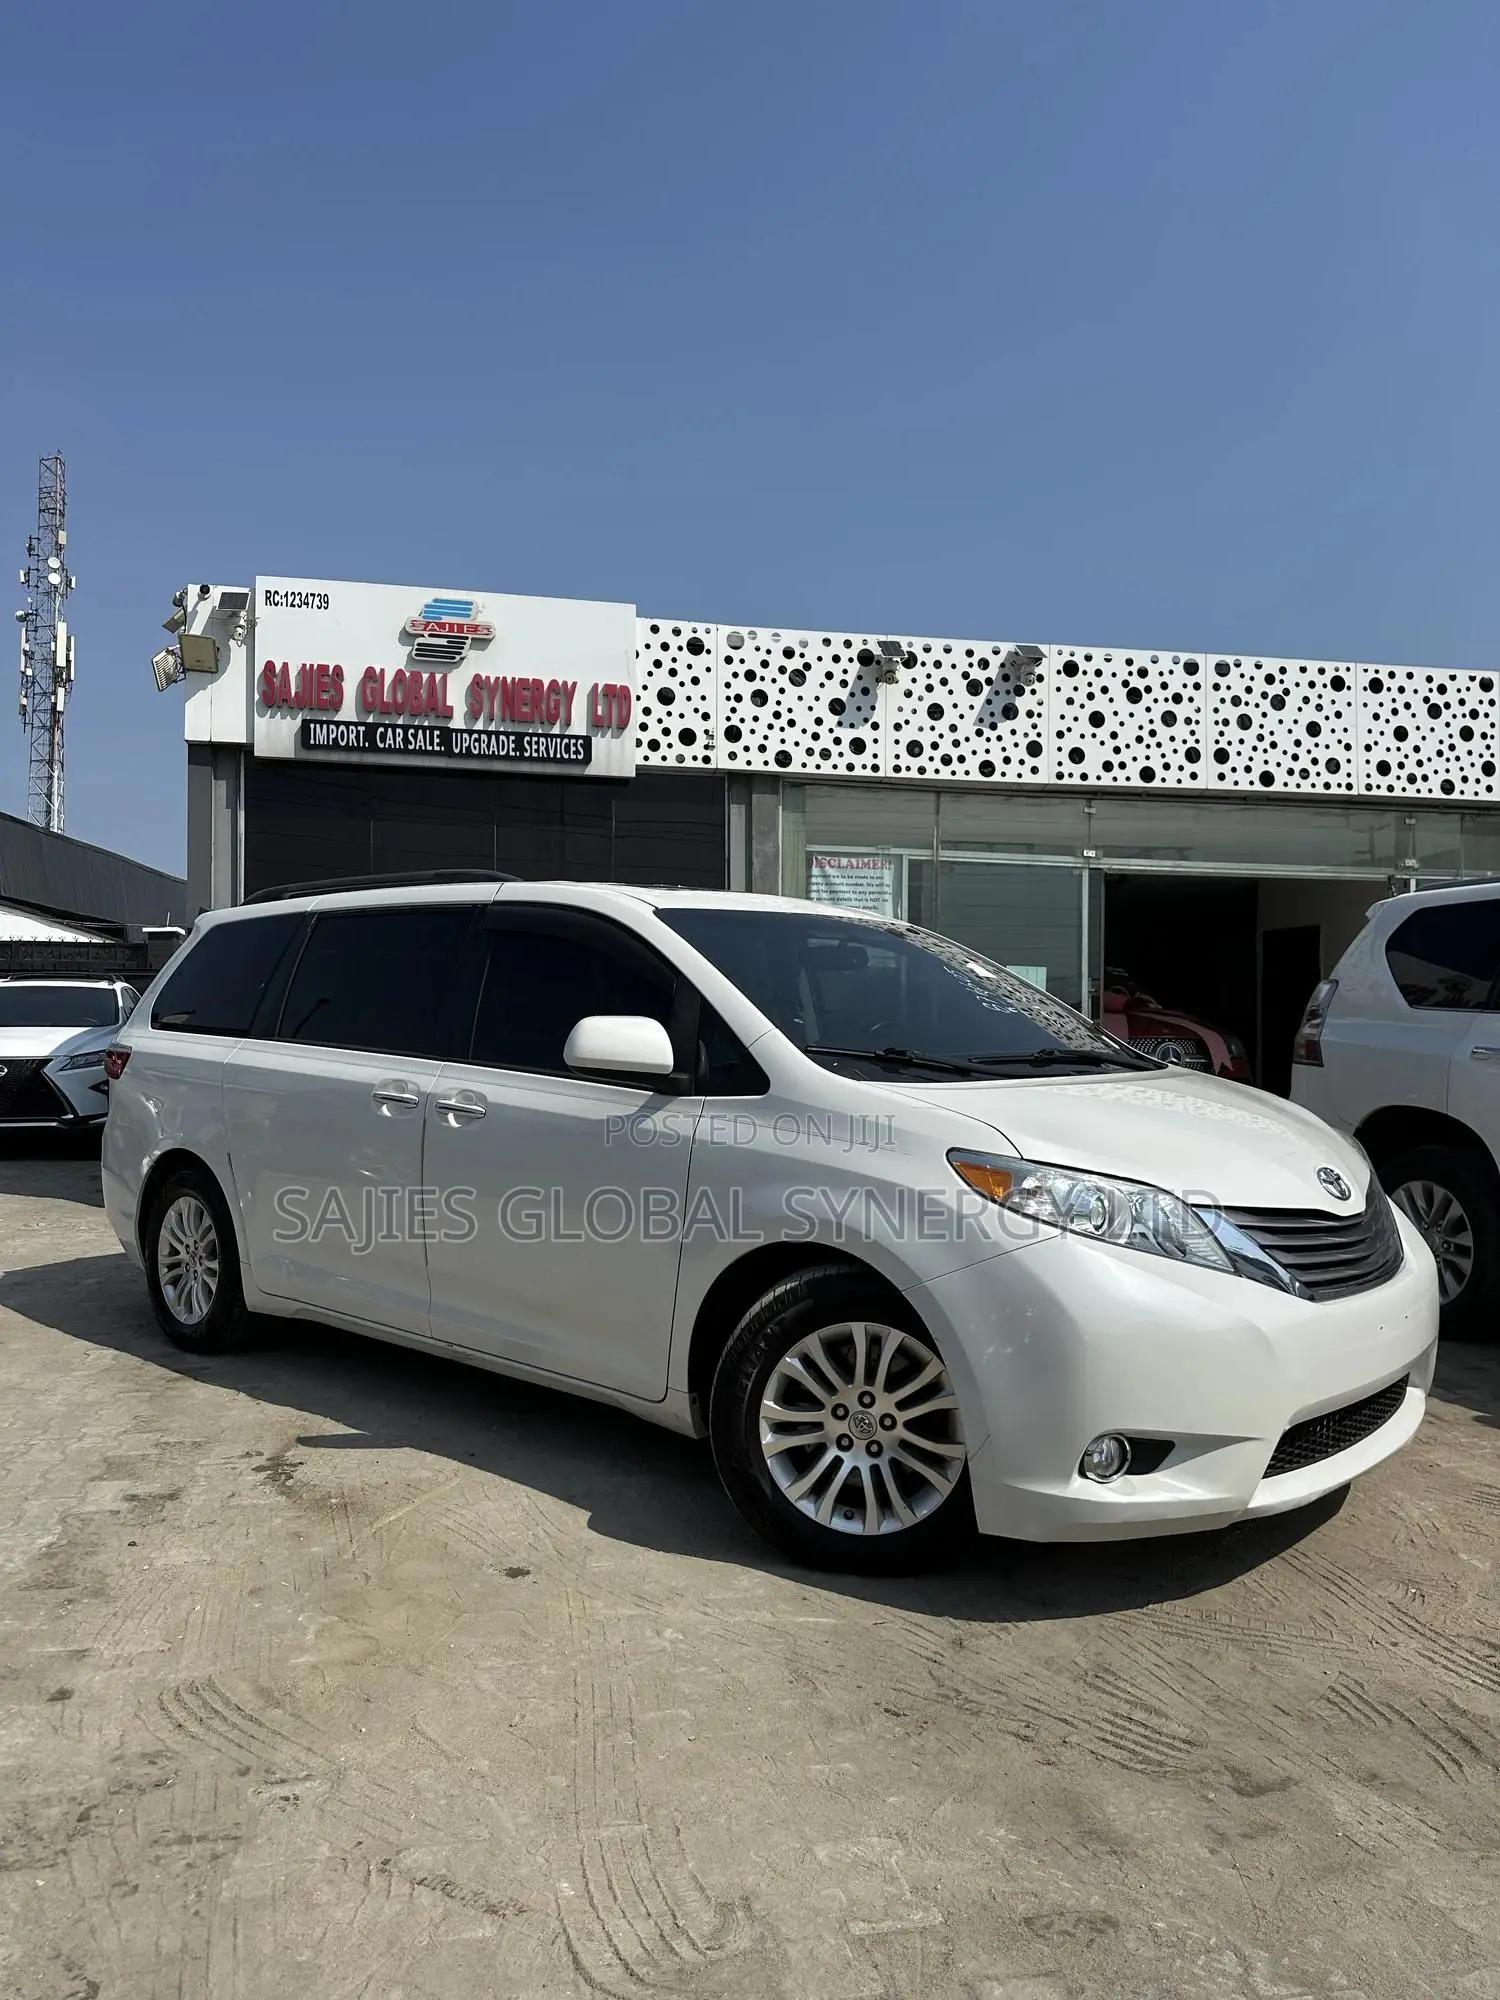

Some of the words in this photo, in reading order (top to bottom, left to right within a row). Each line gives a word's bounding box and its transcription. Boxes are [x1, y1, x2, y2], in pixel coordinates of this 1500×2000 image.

[265, 590, 329, 610] RC:1234739
[409, 619, 493, 636] SAJIES
[262, 661, 344, 710] SAJIES
[362, 666, 453, 717] GLOBAL
[471, 673, 577, 724] SYNERGY
[592, 683, 632, 728] LTD
[309, 724, 369, 747] IMPORT.
[376, 728, 404, 749] CAR
[407, 730, 445, 751] SALE.
[452, 733, 520, 756] UPGRADE.
[523, 737, 584, 759] SERVICES
